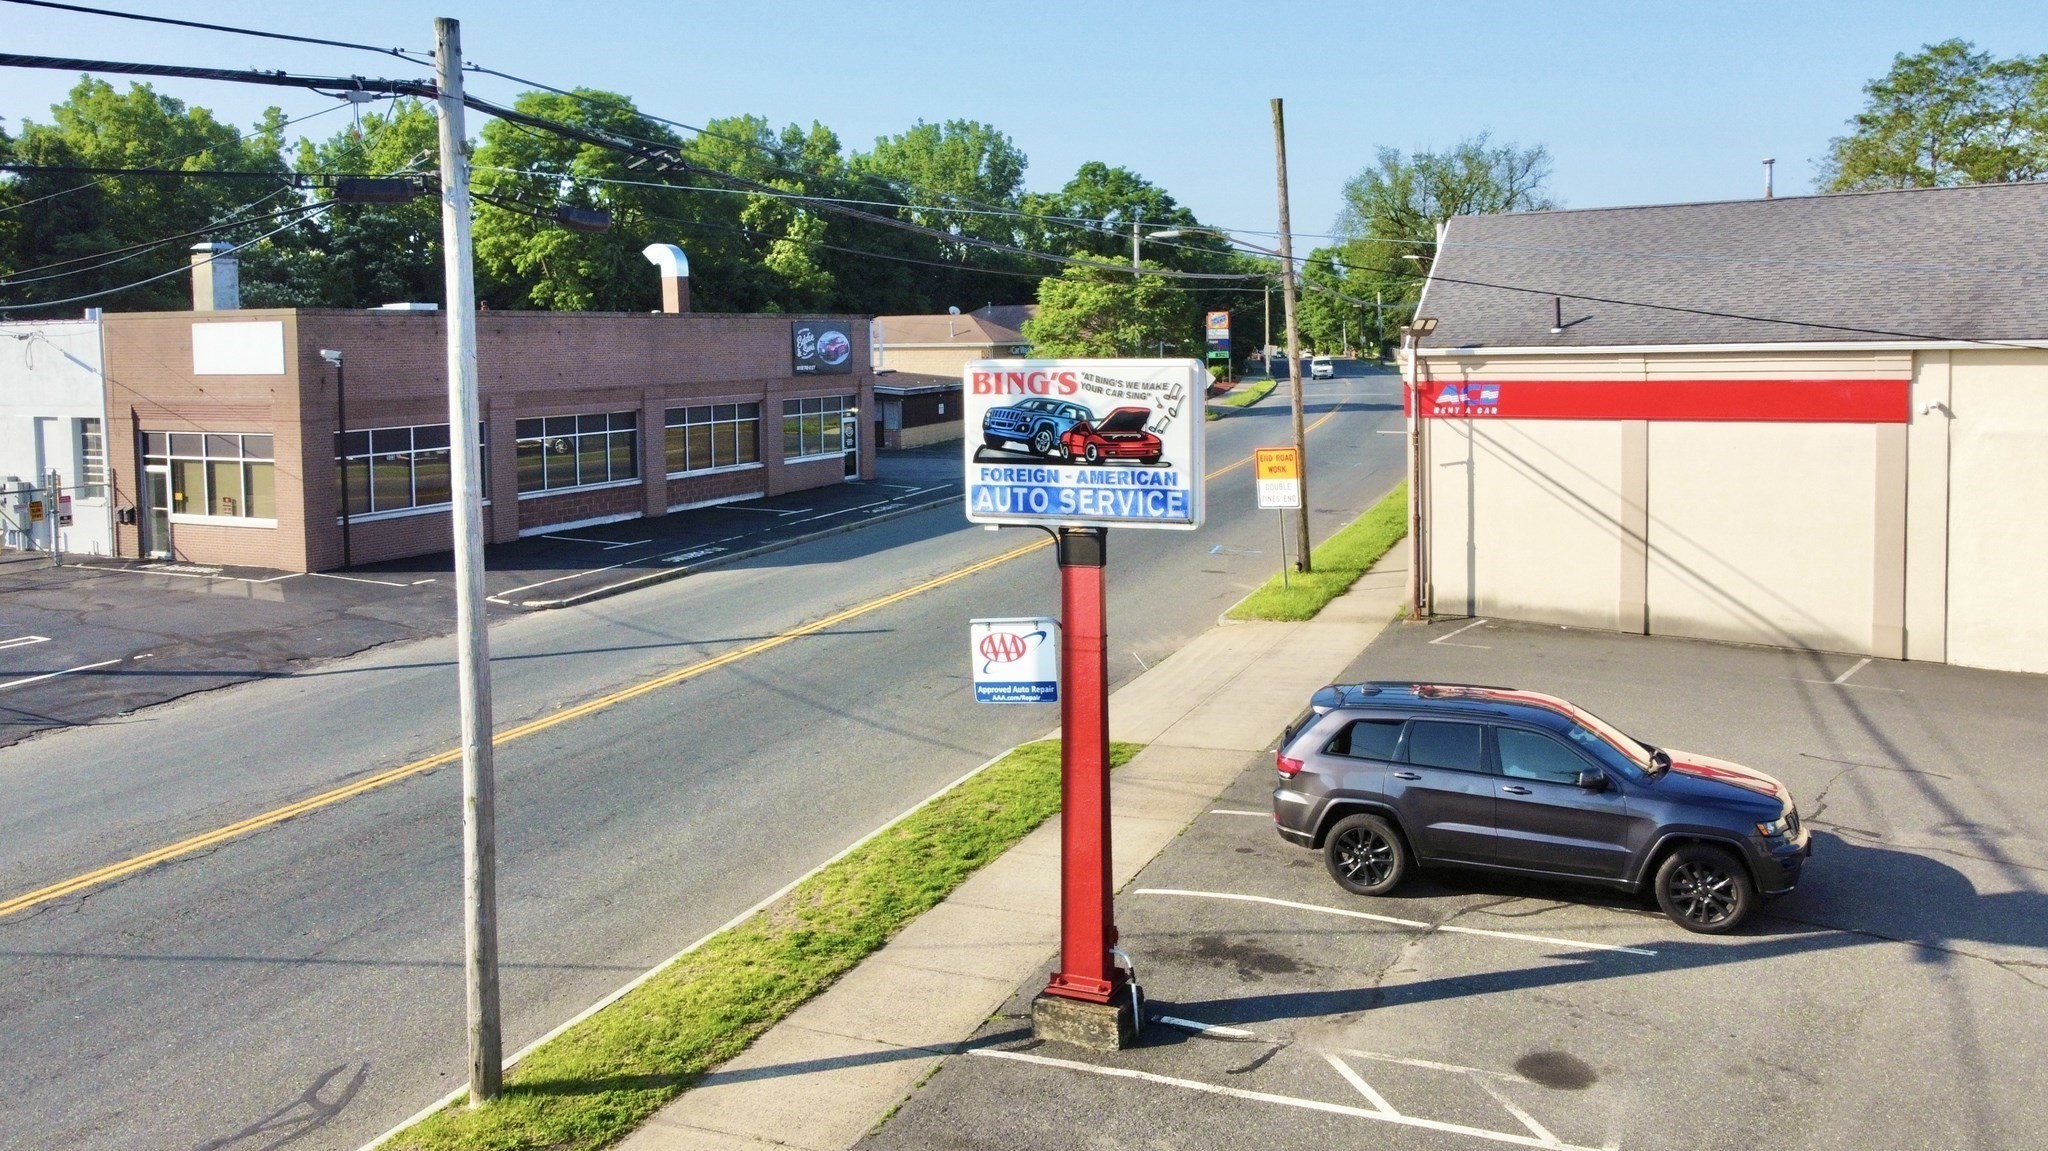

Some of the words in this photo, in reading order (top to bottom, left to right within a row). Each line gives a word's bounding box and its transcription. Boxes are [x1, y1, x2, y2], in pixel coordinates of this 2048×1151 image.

[972, 371, 1078, 395] BING'S
[1080, 381, 1104, 394] YOUR
[1105, 388, 1124, 398] CAR
[1125, 391, 1152, 400] SING"
[1081, 372, 1094, 381] "AT
[1095, 375, 1124, 388] BING'S
[1125, 381, 1139, 390] WE
[1141, 382, 1169, 391] MAKE
[1435, 384, 1500, 406] ACE
[1276, 454, 1294, 462] ROAD
[981, 467, 1060, 484] FOREIGN
[1077, 470, 1178, 486] AMERICAN
[974, 487, 1049, 513] AUTO
[1060, 489, 1186, 517] SERVICE
[985, 632, 1021, 662] AAA
[978, 685, 1011, 694] Approved
[1012, 685, 1030, 693] Auto
[1031, 685, 1054, 694] Repair
